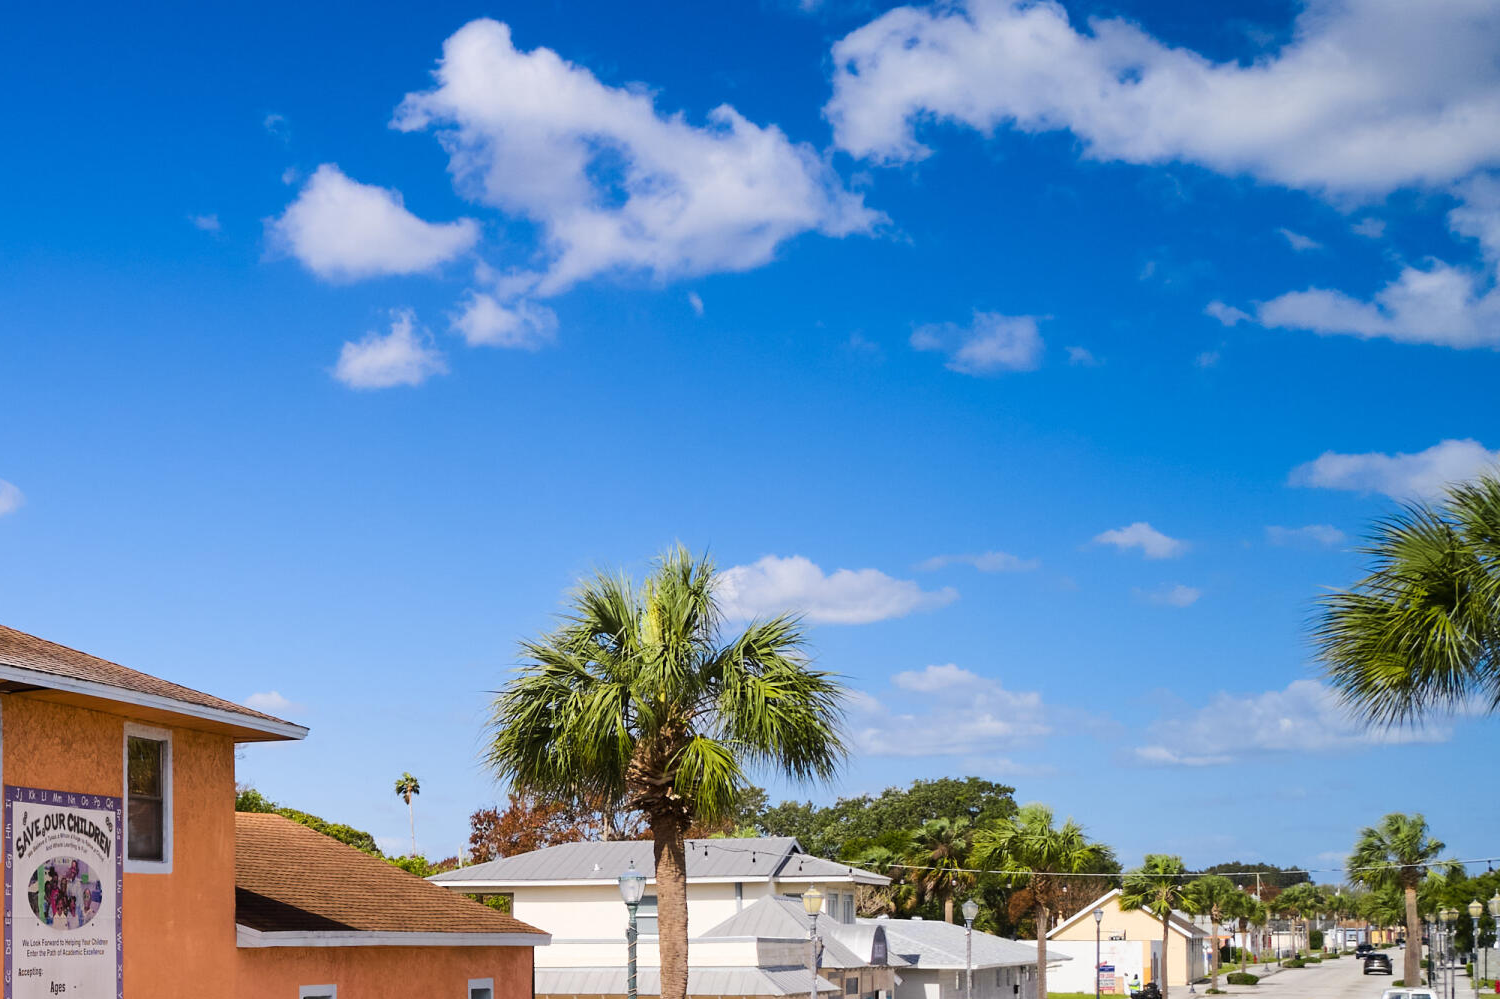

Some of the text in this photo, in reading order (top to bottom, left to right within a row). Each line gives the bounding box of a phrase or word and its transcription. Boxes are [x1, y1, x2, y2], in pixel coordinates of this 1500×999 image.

[16, 812, 112, 859] SAVE OUR CHILDREN
[22, 939, 30, 947] We
[30, 939, 41, 947] Look
[42, 938, 59, 946] Forward
[65, 938, 81, 948] Helping
[91, 938, 108, 946] Children
[26, 949, 39, 957] Enter
[62, 948, 83, 956] Academic
[83, 948, 105, 956] Excellence
[17, 967, 44, 978] Accepting:
[50, 980, 66, 996] Ages
